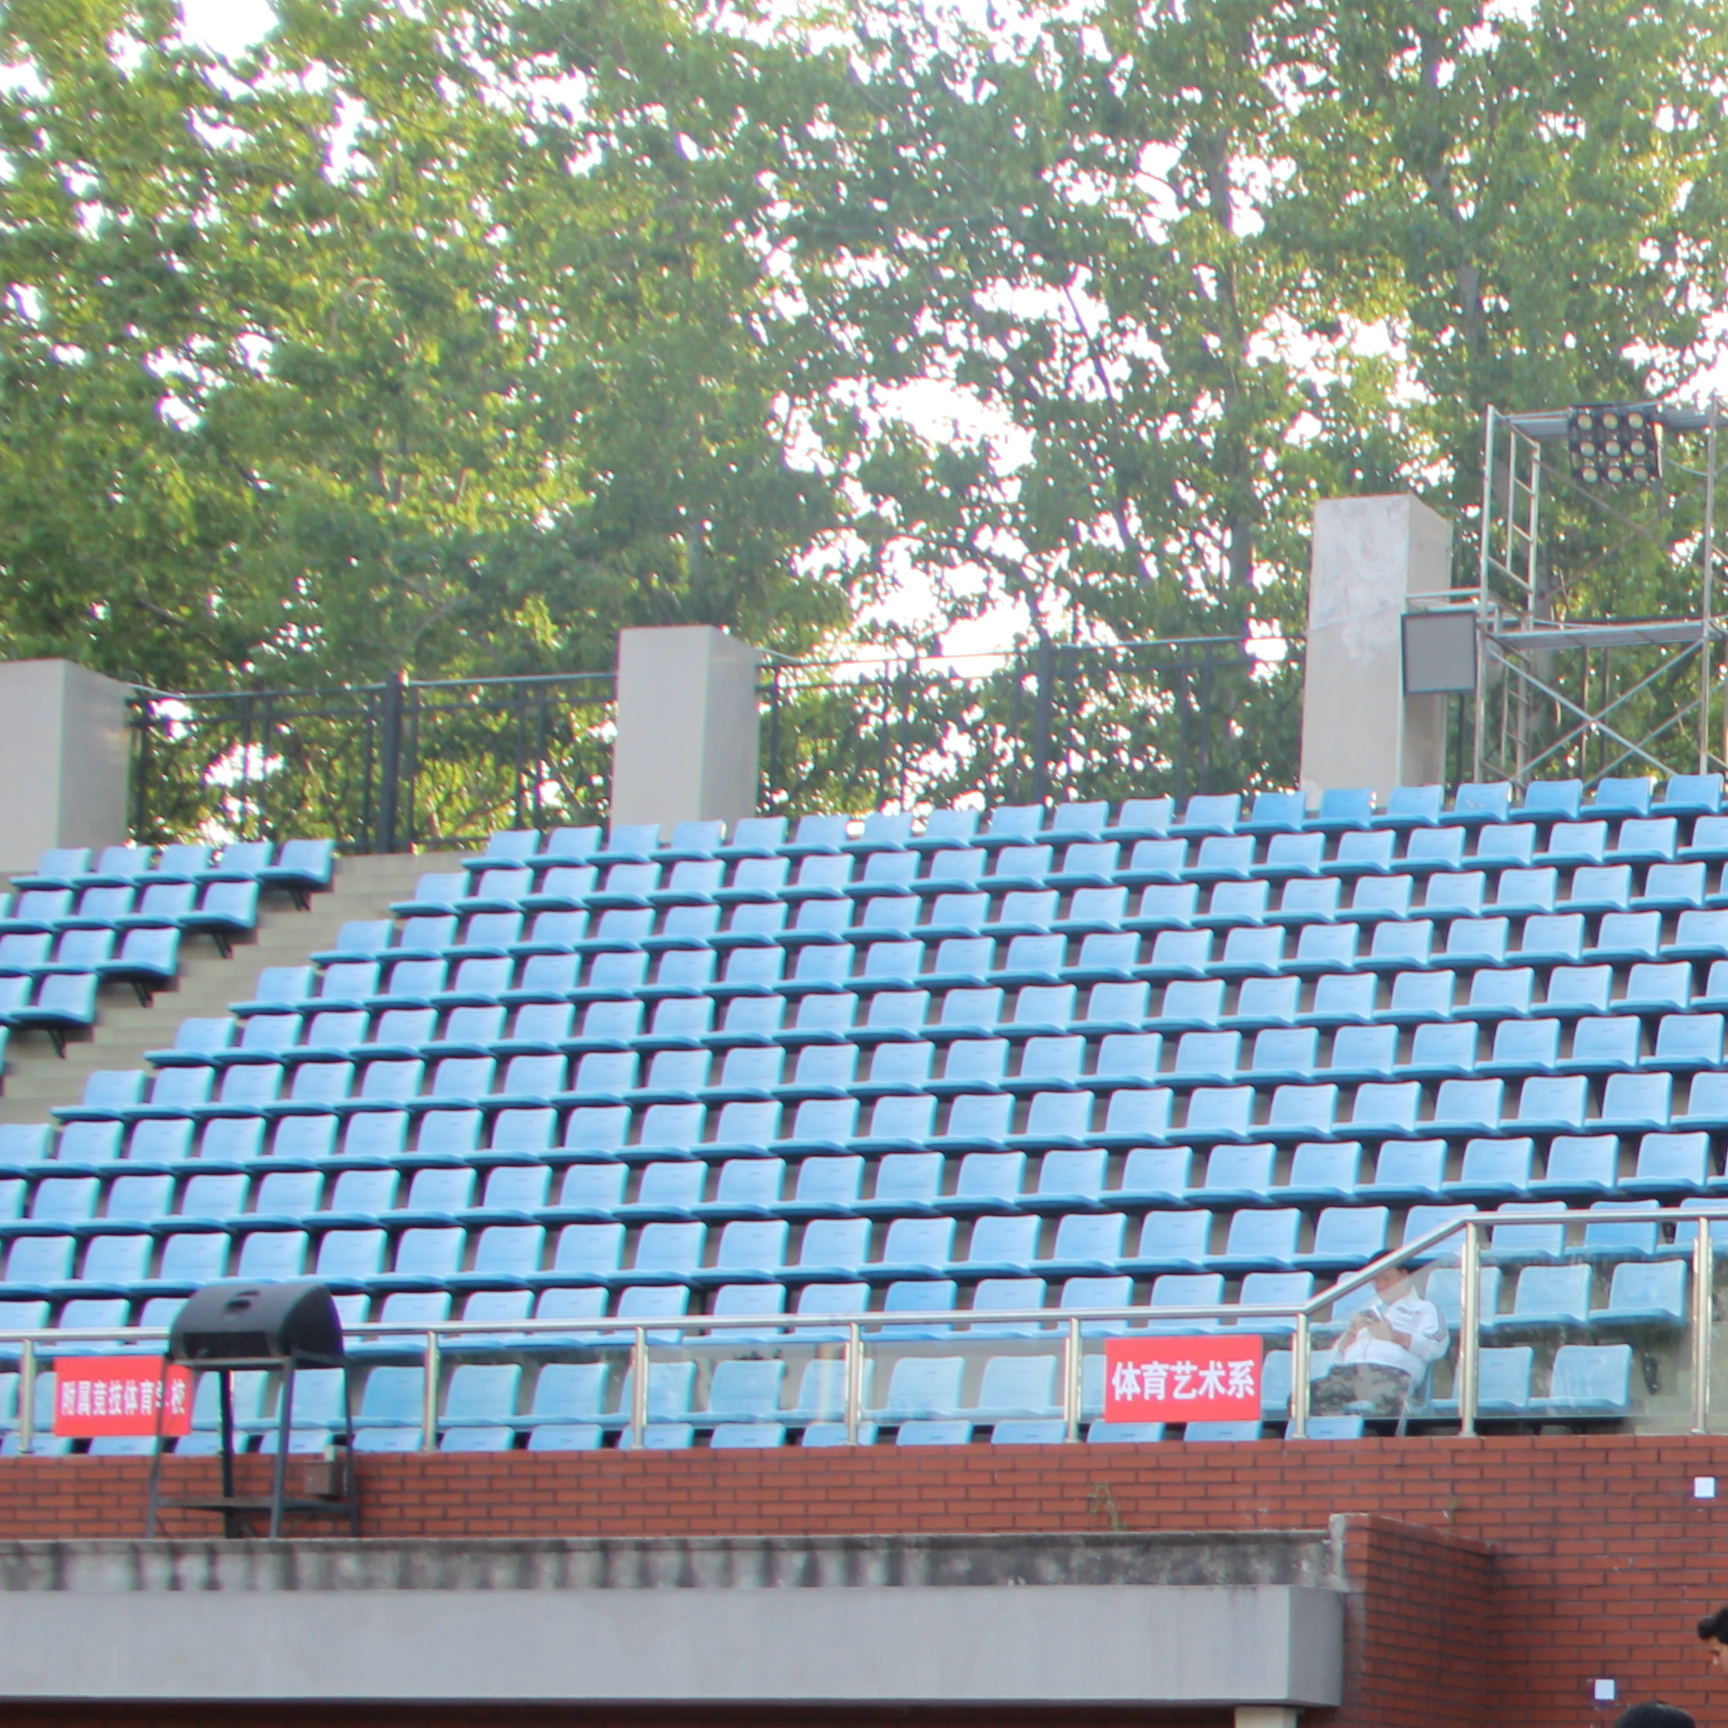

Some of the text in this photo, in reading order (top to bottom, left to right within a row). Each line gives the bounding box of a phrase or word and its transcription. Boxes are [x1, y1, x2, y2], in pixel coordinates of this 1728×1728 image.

[1111, 1359, 1255, 1402] 体育艺术系
